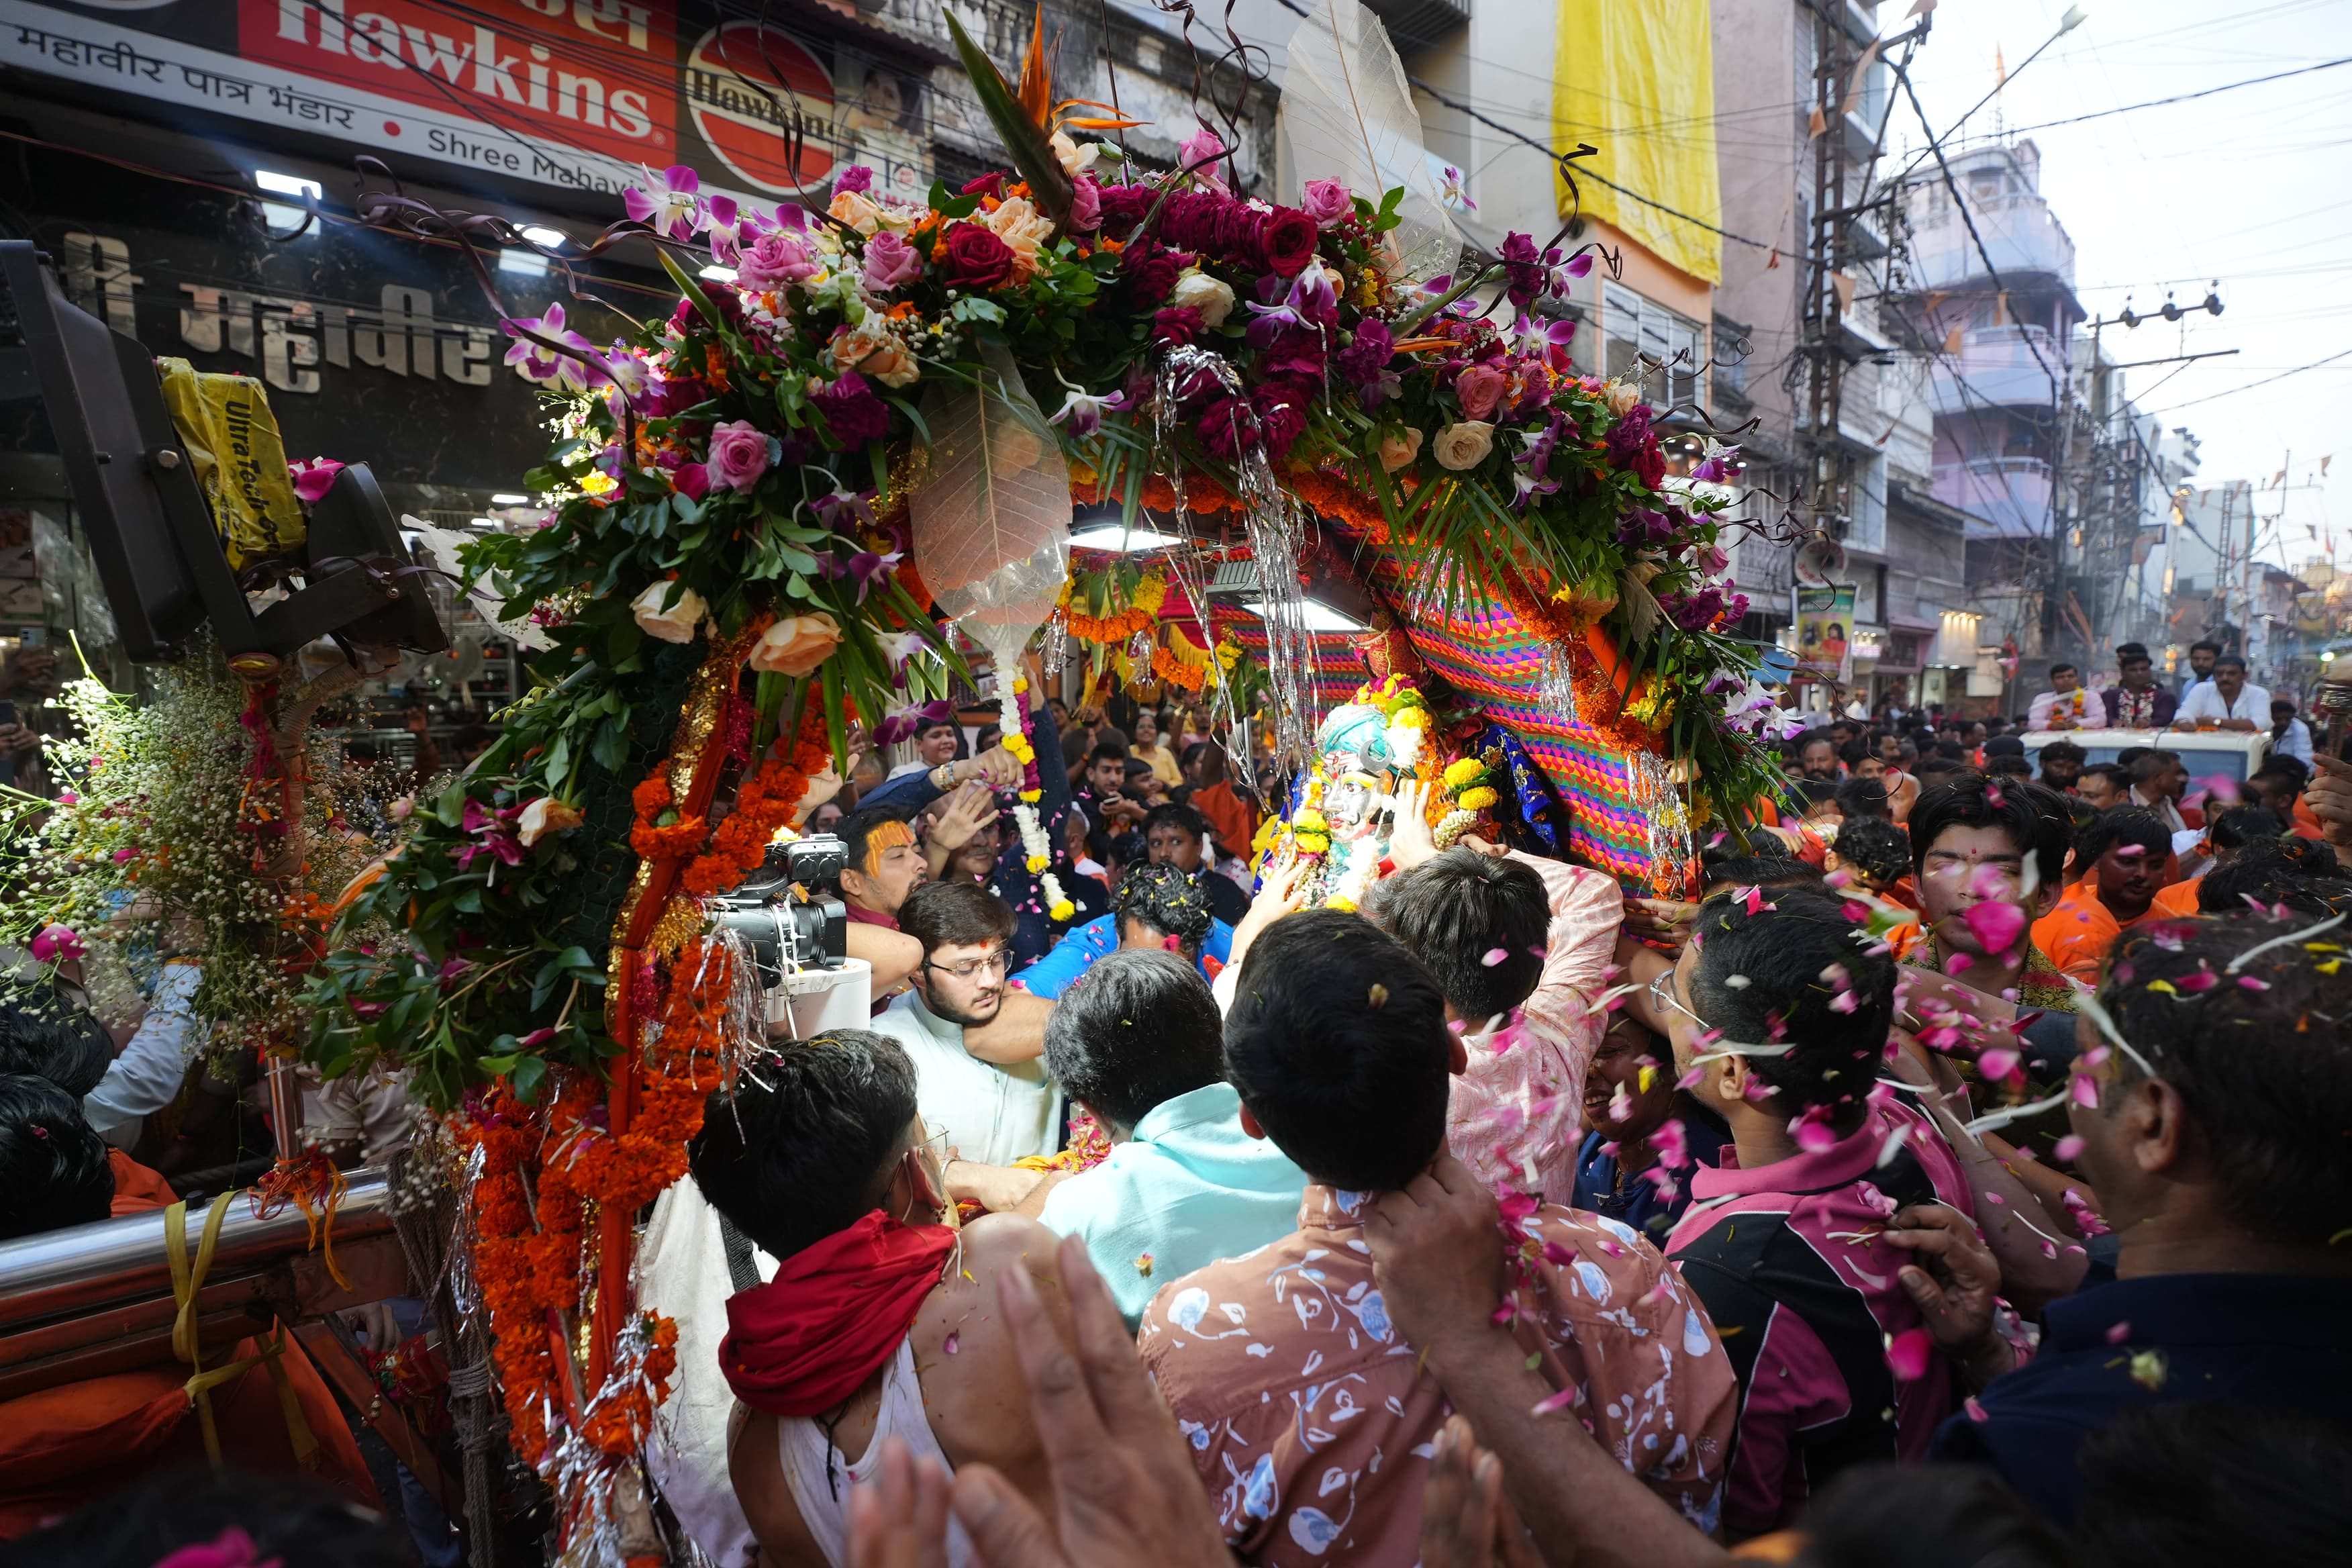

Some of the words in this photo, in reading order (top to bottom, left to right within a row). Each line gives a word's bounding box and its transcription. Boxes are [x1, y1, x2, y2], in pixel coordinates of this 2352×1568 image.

[17, 24, 166, 82] महावीर
[180, 66, 254, 105] पात्र
[268, 85, 356, 130] भंडार
[428, 130, 520, 170] Shree
[179, 283, 497, 393] महावीर
